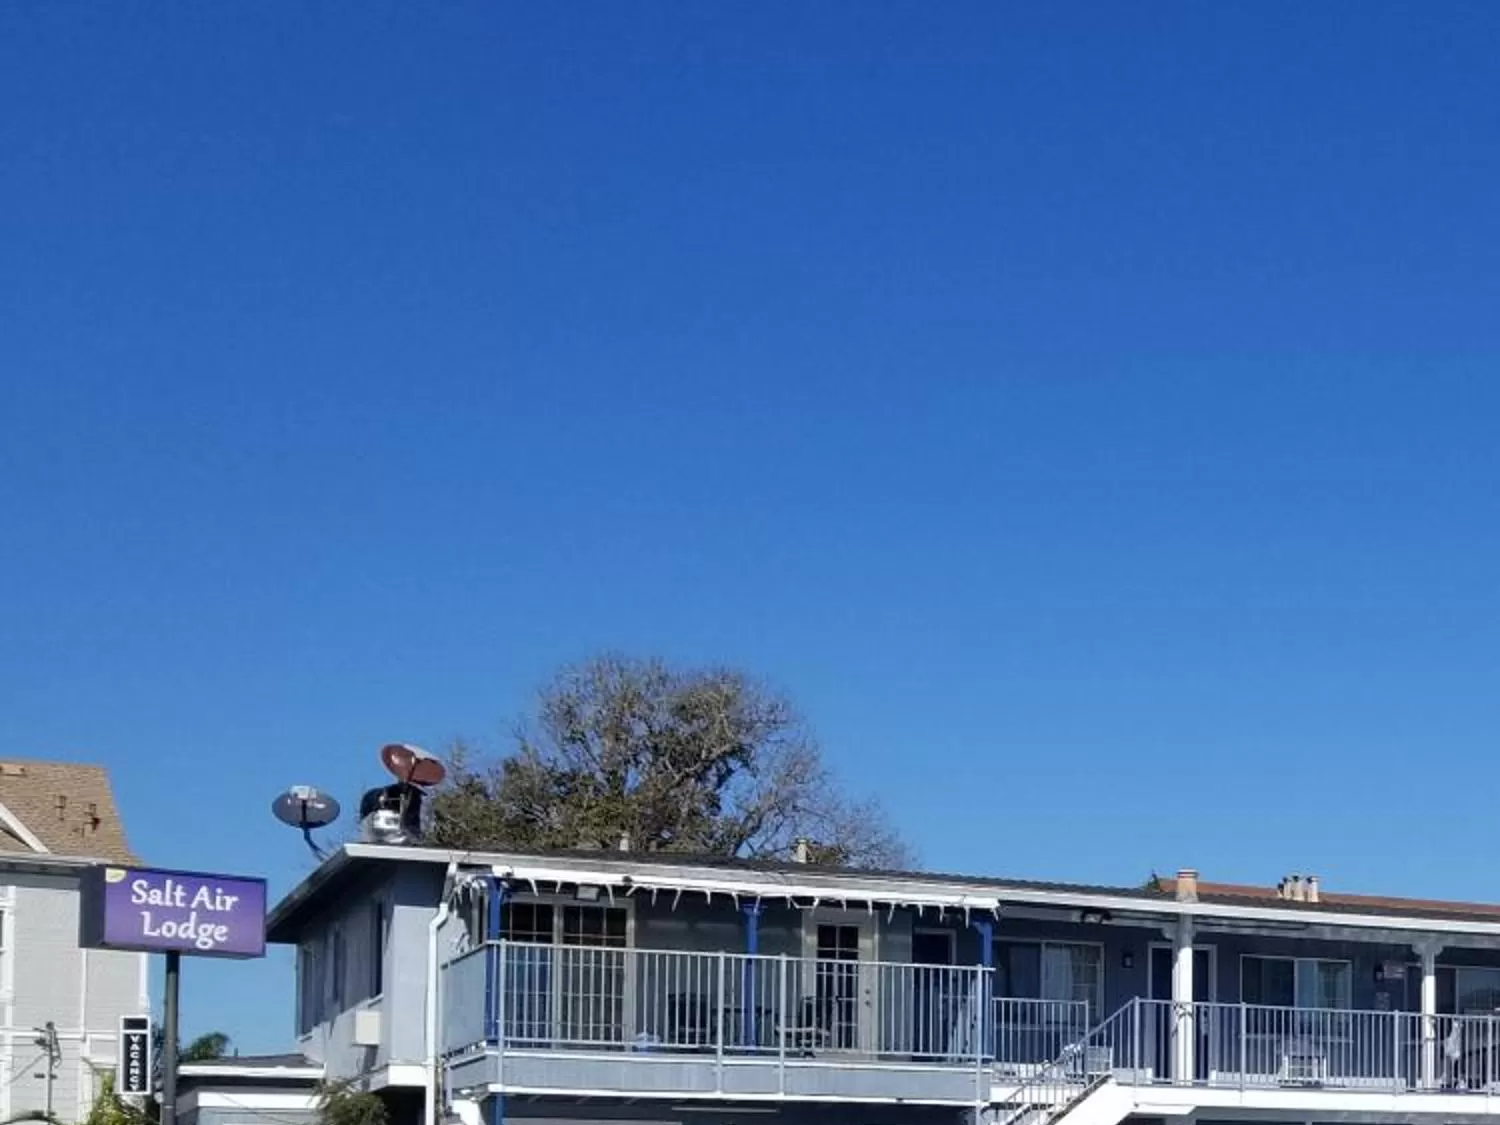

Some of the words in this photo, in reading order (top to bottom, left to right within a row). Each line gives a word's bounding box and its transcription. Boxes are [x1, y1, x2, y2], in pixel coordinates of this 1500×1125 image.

[131, 879, 187, 908] Salt
[190, 885, 239, 912] Air
[140, 911, 229, 949] Lodge
[129, 1034, 141, 1092] VACANCY
